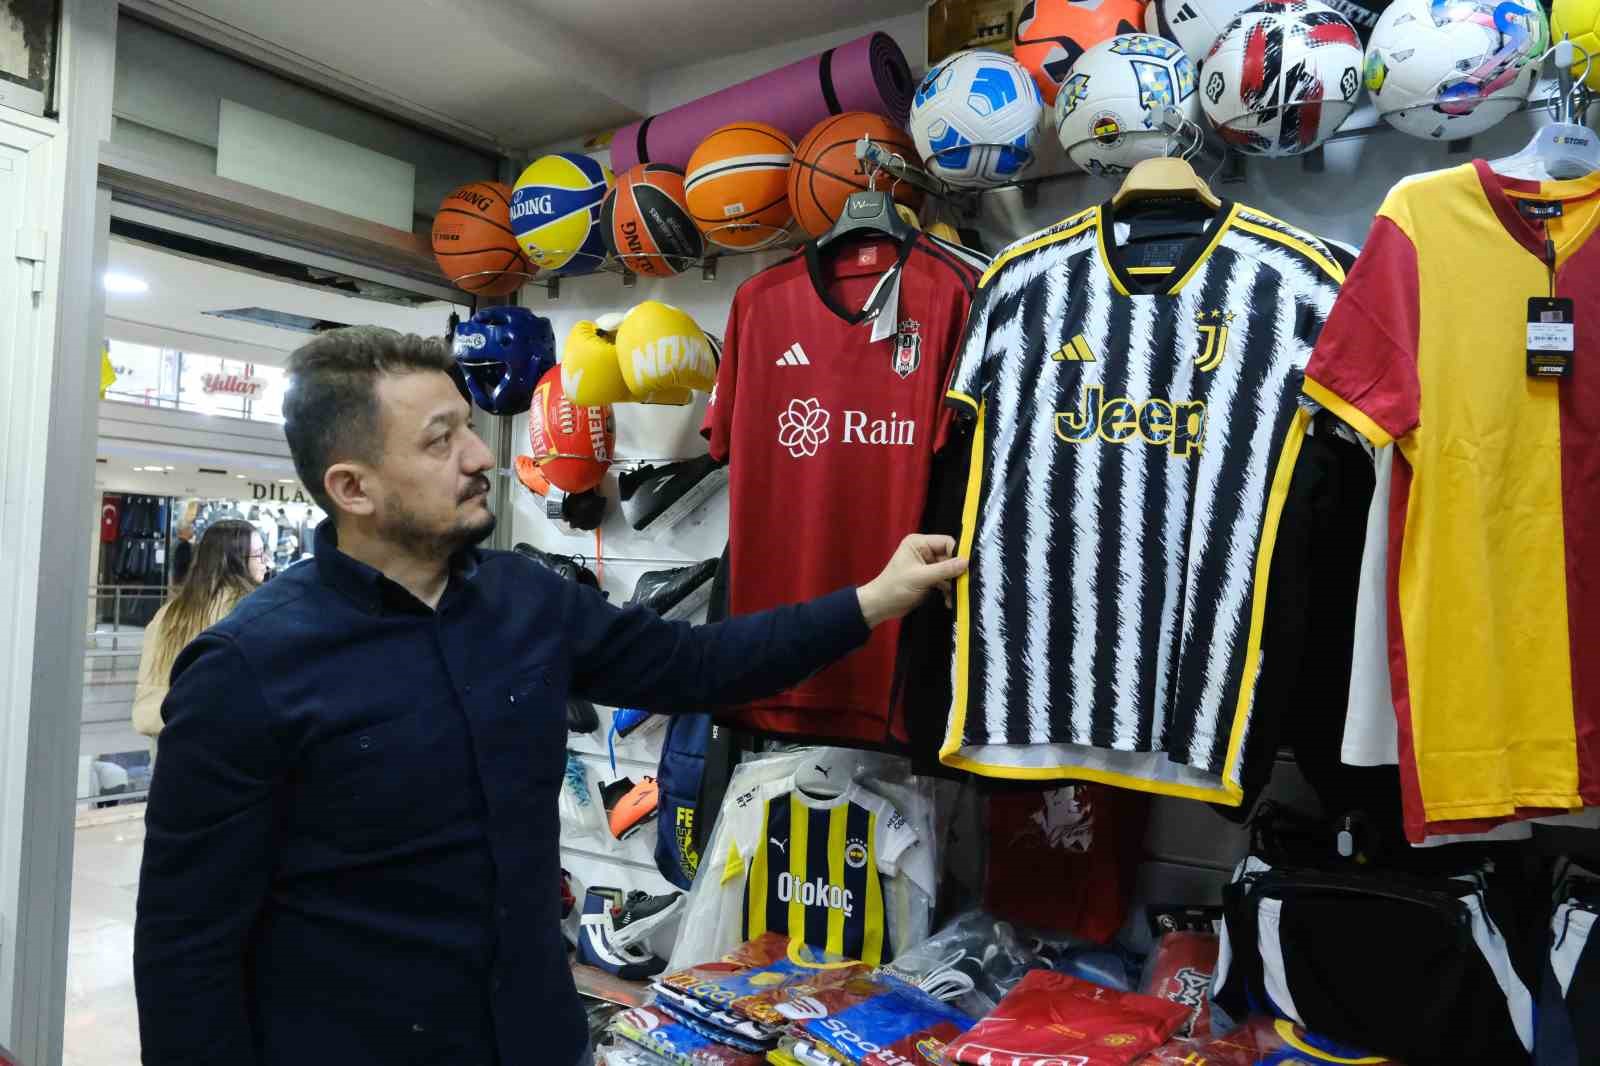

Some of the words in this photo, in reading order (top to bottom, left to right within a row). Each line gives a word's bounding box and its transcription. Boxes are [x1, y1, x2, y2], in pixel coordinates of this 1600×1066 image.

[456, 190, 495, 212] DING
[842, 410, 915, 445] Rain
[1055, 384, 1208, 456] Jeep
[253, 483, 309, 503] DİLA
[777, 871, 854, 918] Otokoç
